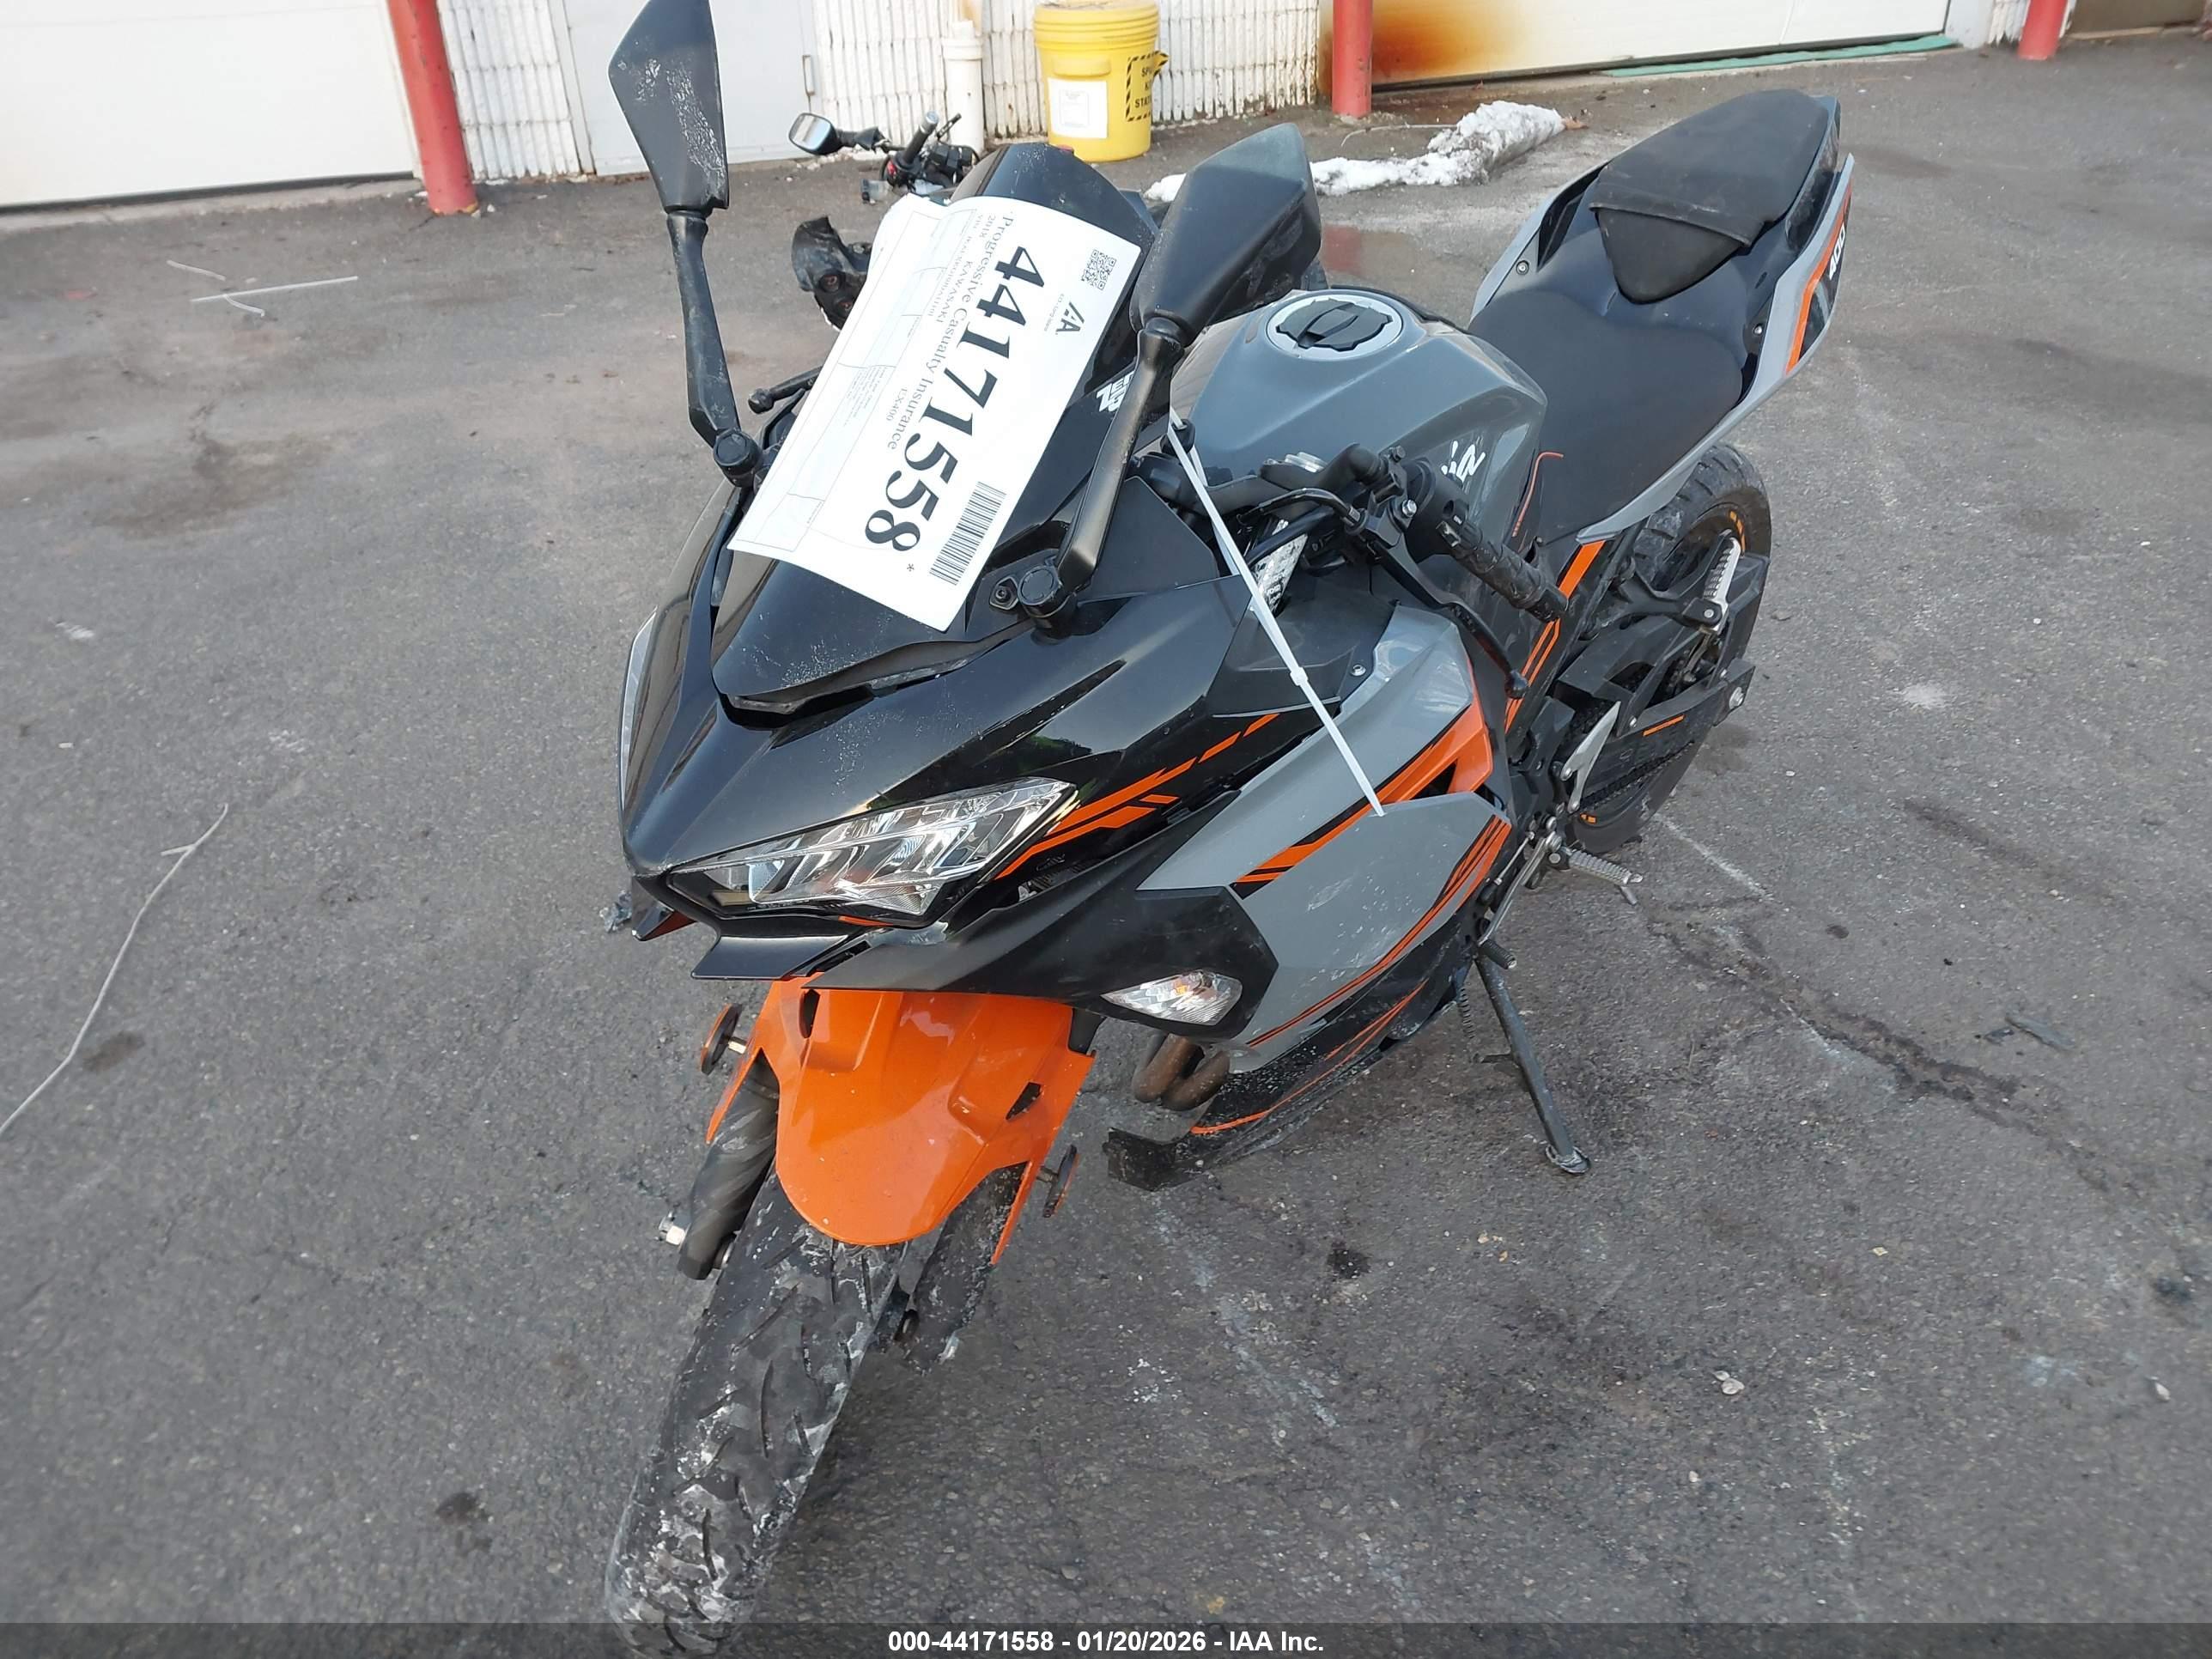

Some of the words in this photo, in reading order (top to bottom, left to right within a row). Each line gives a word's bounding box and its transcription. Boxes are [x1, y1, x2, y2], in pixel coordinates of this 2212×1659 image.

[961, 216, 1015, 303] Progressive
[1829, 222, 1846, 281] 400
[935, 260, 974, 324] KAWASAKI
[925, 307, 968, 374] Casualty
[865, 246, 1045, 552] 44171558
[886, 378, 935, 451] Insurance
